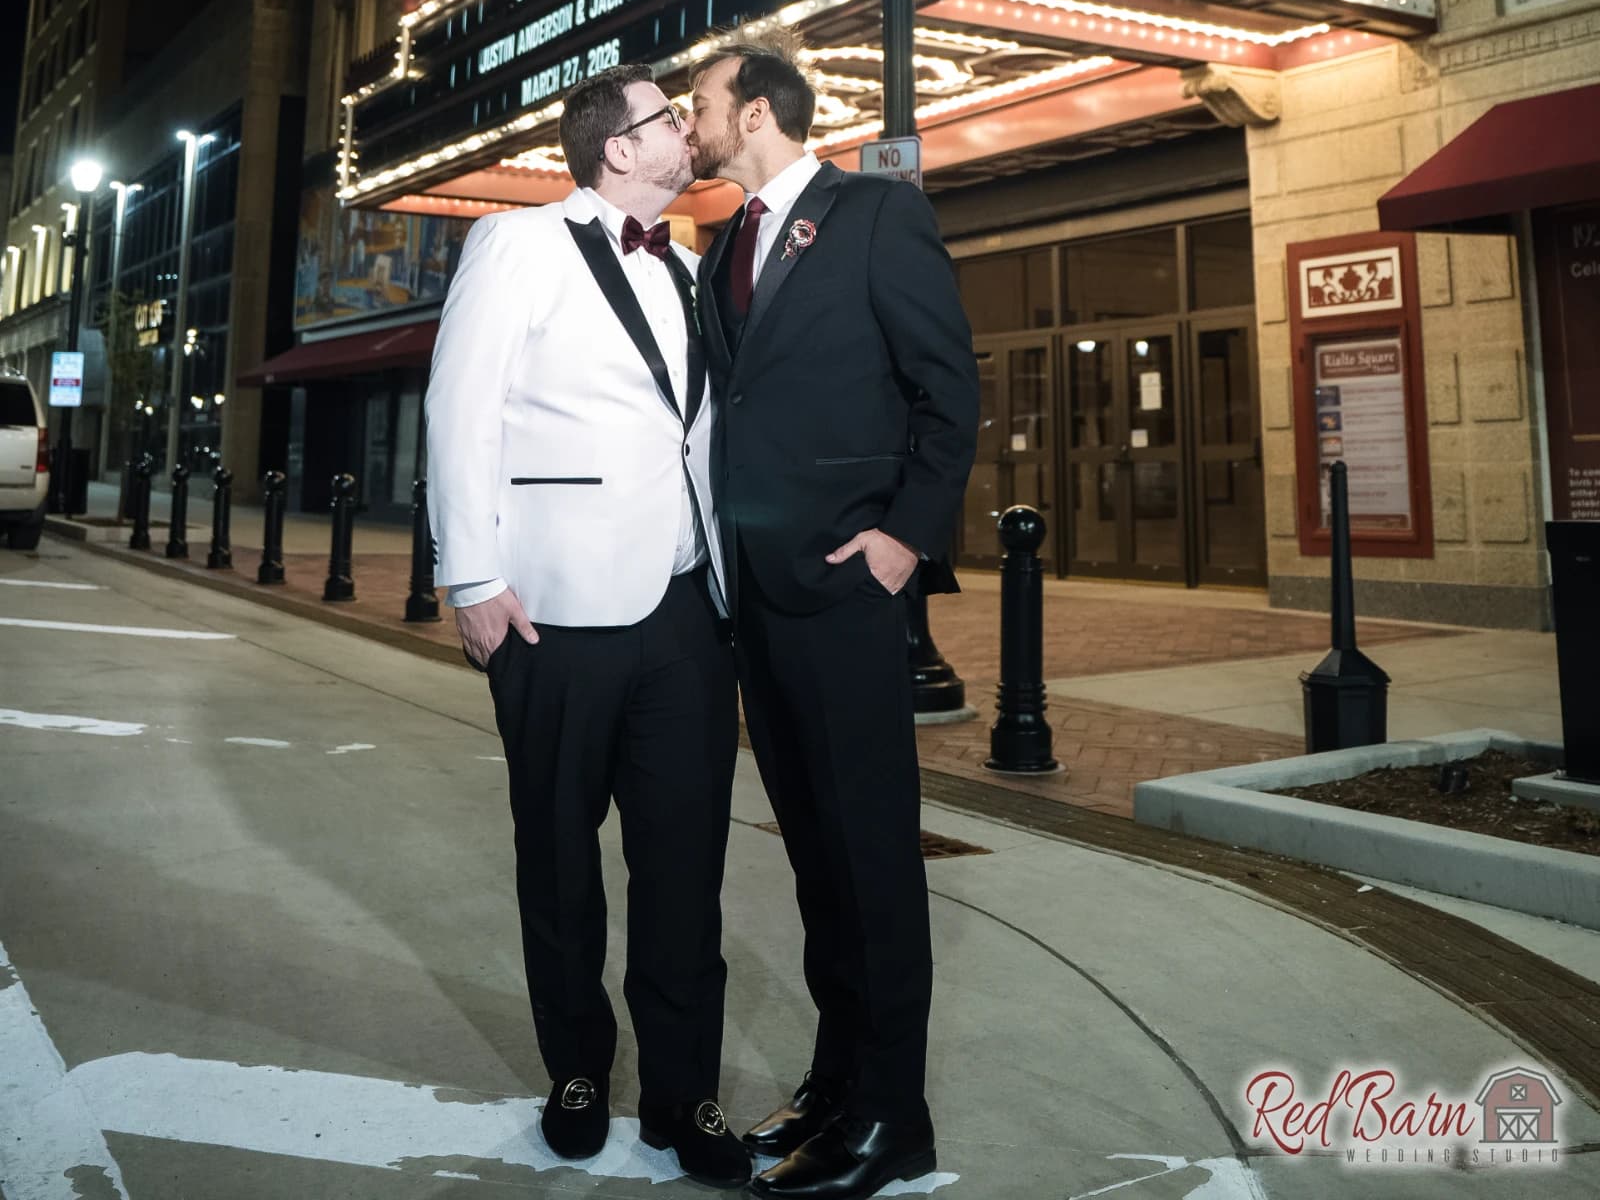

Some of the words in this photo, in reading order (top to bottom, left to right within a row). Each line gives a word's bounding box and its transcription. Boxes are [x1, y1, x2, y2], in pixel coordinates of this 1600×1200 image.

[477, 33, 516, 74] JUSTIN
[516, 2, 574, 56] ANDERSON
[521, 70, 560, 106] MARCH
[587, 38, 620, 78] 2026
[878, 149, 901, 168] NO
